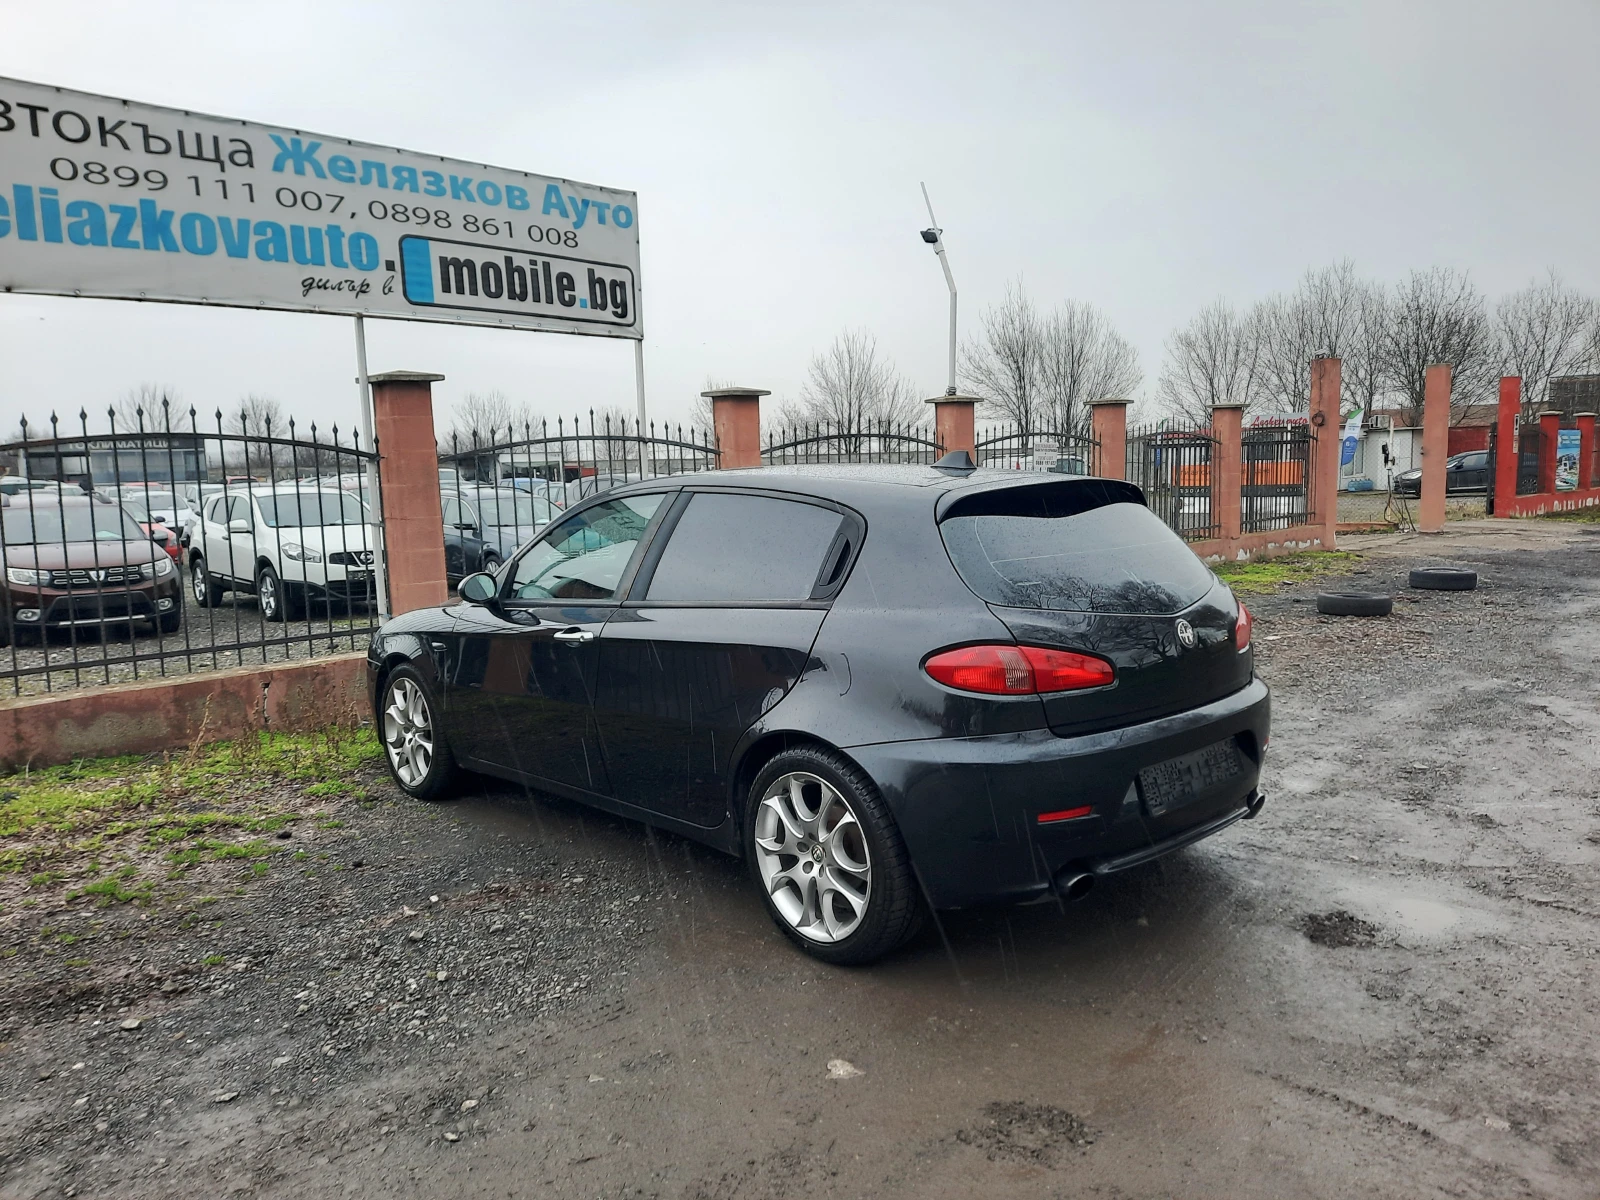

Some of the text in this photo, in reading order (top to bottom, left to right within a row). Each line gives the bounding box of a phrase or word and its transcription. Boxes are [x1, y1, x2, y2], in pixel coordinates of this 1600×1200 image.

[50, 157, 579, 248] 0899 111 007, 0898 861 008
[268, 132, 531, 211] Желязков
[542, 183, 633, 229] Ауто
[0, 183, 396, 272] liazkovauto.
[301, 277, 371, 299] дилър
[439, 255, 628, 319] mobile.bg
